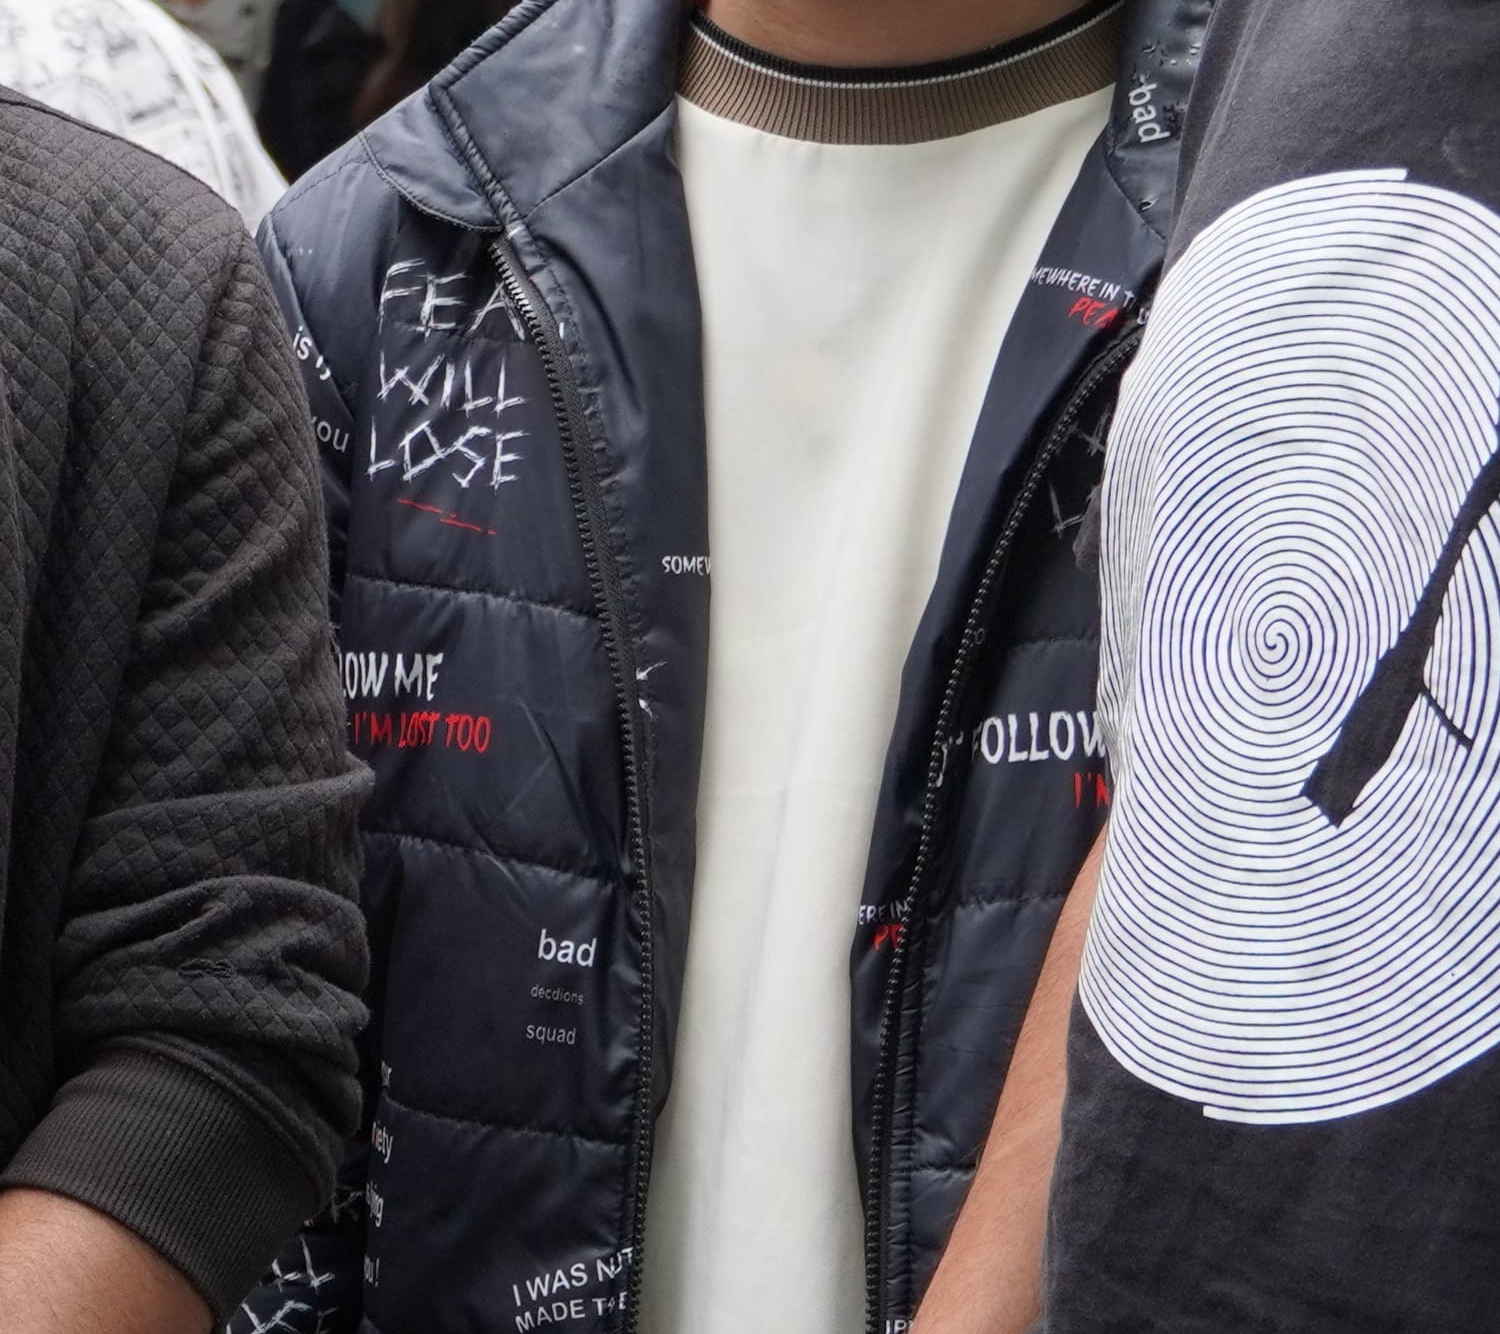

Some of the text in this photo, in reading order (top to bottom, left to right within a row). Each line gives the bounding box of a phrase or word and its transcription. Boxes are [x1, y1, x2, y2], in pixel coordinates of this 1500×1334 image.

[1129, 81, 1171, 144] bad
[378, 257, 526, 342] FEA
[1101, 282, 1120, 301] IN
[376, 351, 525, 419] WILL
[366, 416, 530, 492] LOSE
[394, 652, 445, 702] ME
[354, 711, 493, 755] I'M LOST TOO
[538, 928, 597, 967] bad
[530, 983, 585, 1006] decdions
[526, 1023, 577, 1045] squad
[512, 1283, 522, 1307] I
[526, 1263, 588, 1302] WAS
[515, 1298, 587, 1334] MADE
